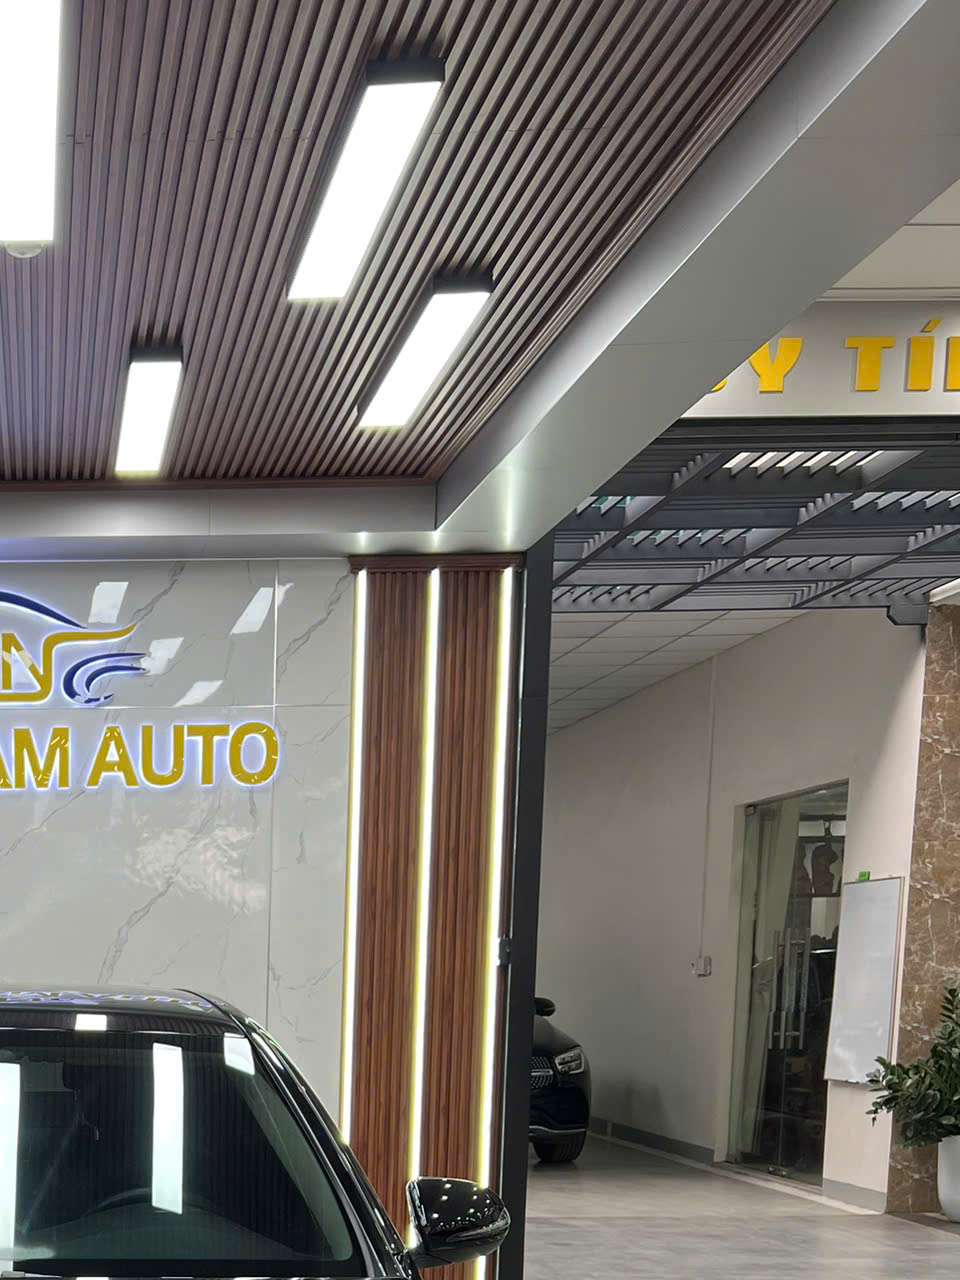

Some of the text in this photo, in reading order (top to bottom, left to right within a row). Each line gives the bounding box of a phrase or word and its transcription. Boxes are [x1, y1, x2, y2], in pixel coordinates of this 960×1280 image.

[712, 317, 960, 393] Y TÍ
[87, 722, 279, 787] AUTO
